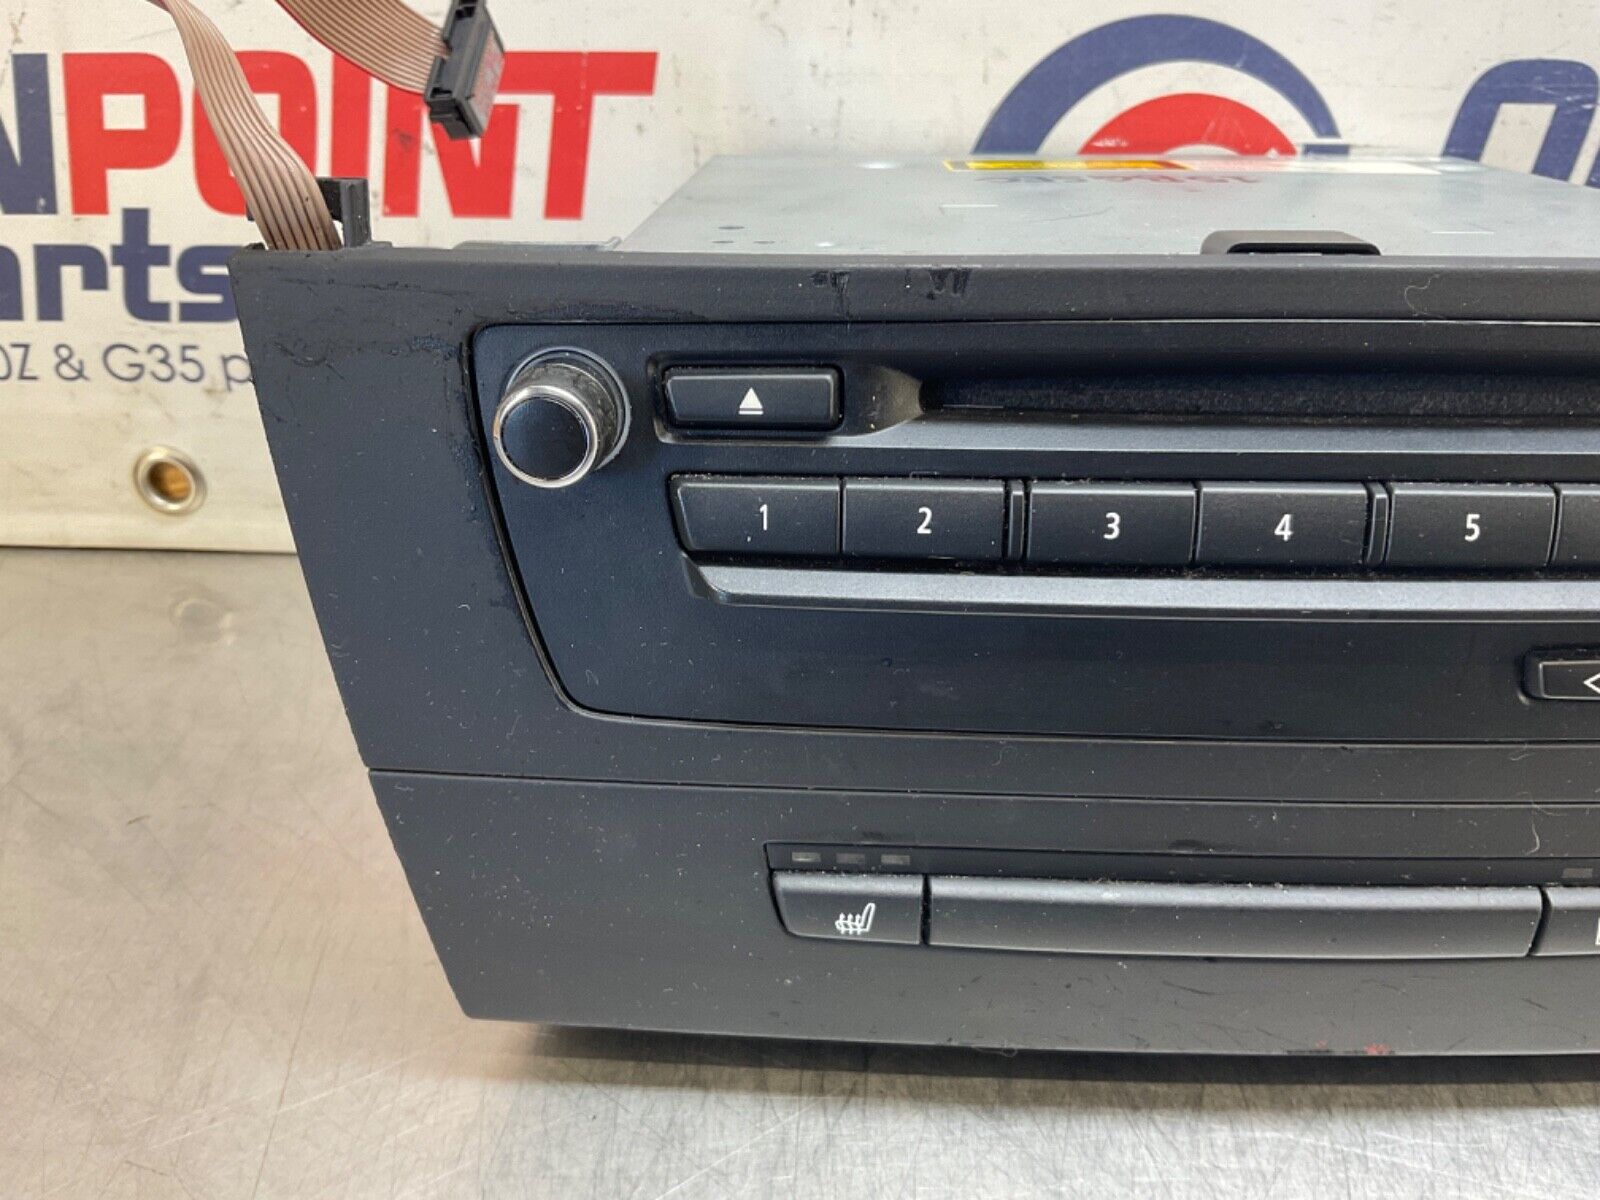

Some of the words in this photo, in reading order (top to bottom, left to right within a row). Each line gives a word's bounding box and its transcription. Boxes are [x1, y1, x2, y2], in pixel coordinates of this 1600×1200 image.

[54, 343, 90, 381] &
[103, 343, 205, 382] G35
[759, 503, 768, 531] 1
[916, 506, 933, 535] 2
[1103, 511, 1121, 540] 3
[1273, 513, 1294, 542] 4
[1464, 513, 1481, 542] 5
